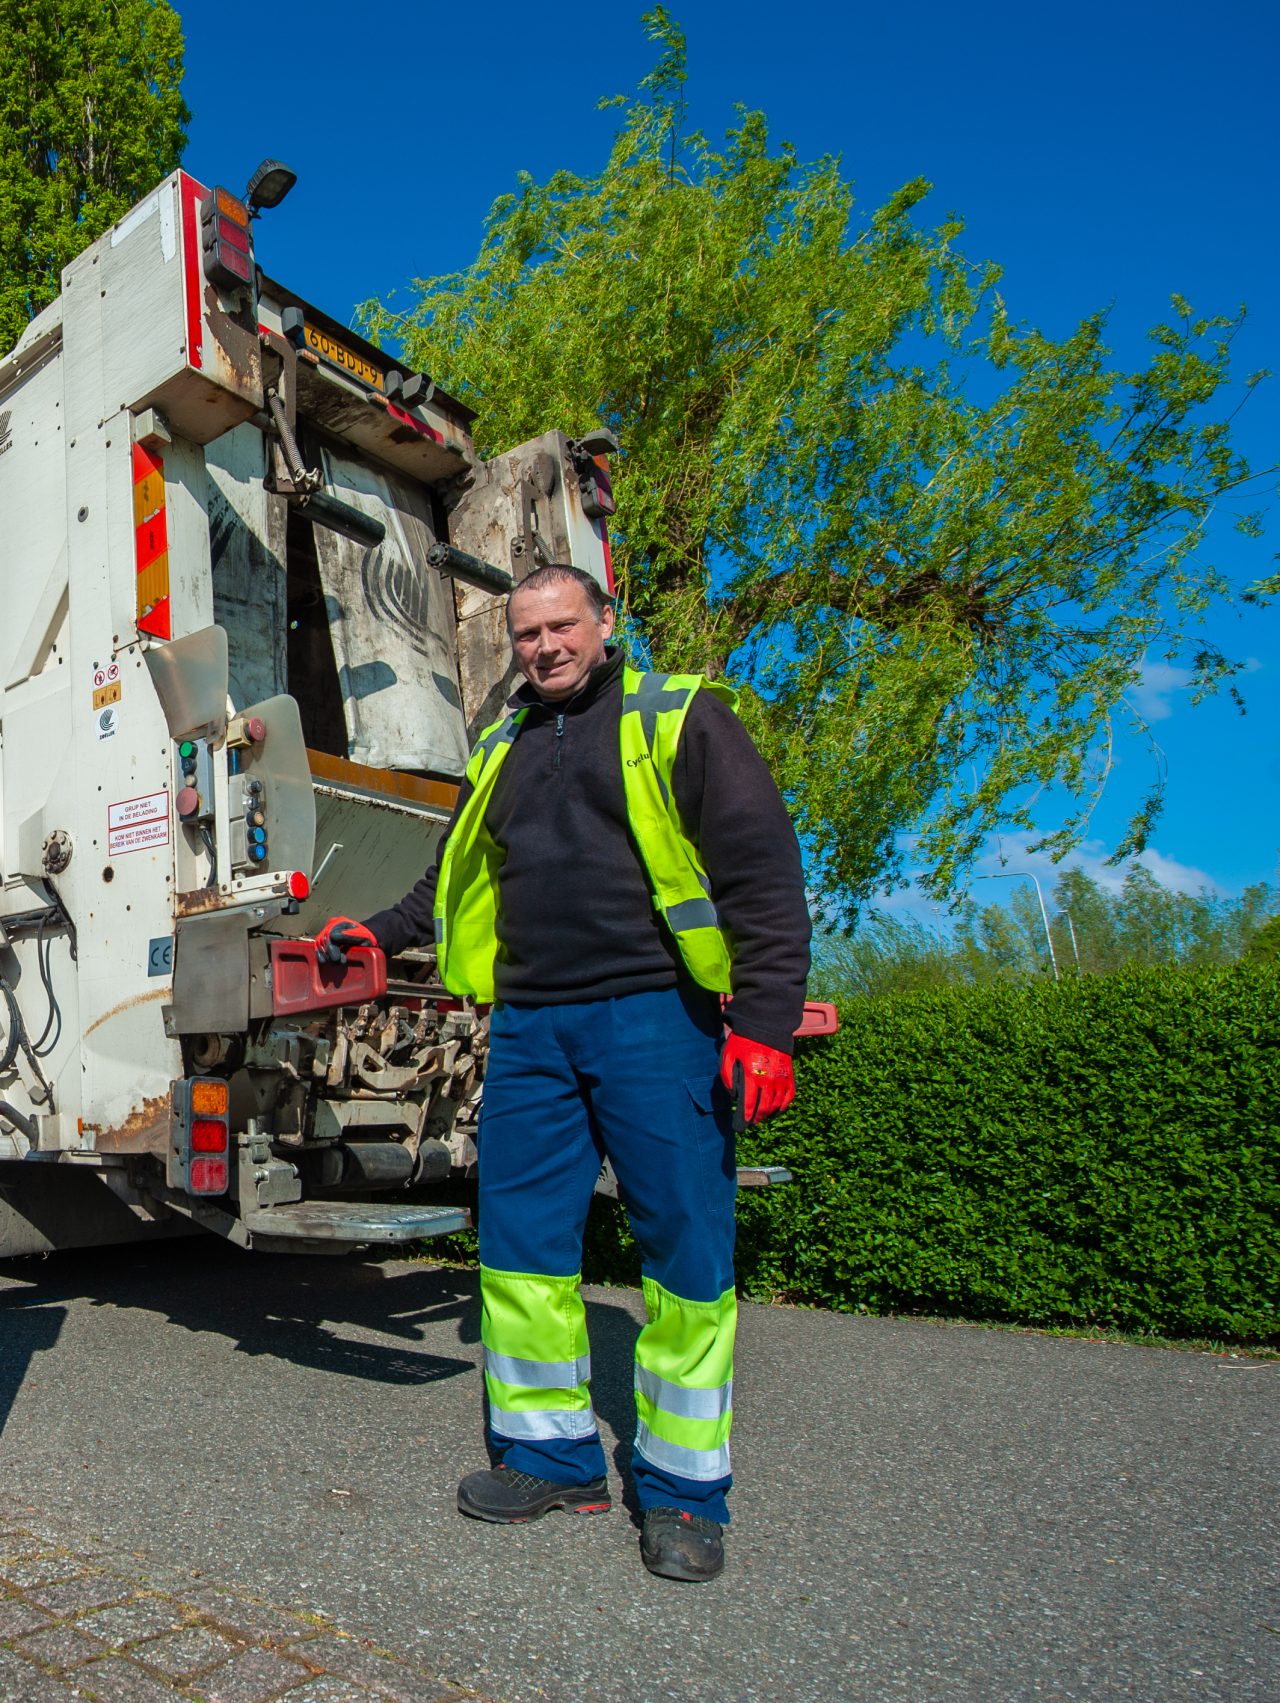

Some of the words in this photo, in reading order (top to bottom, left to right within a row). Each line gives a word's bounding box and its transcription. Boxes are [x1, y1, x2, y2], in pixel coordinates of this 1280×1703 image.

[310, 329, 378, 384] 60-BDJ-9
[626, 752, 650, 768] Cyclu
[140, 801, 152, 809] NIET
[133, 807, 158, 819] BELADING
[136, 828, 152, 837] BINNEN
